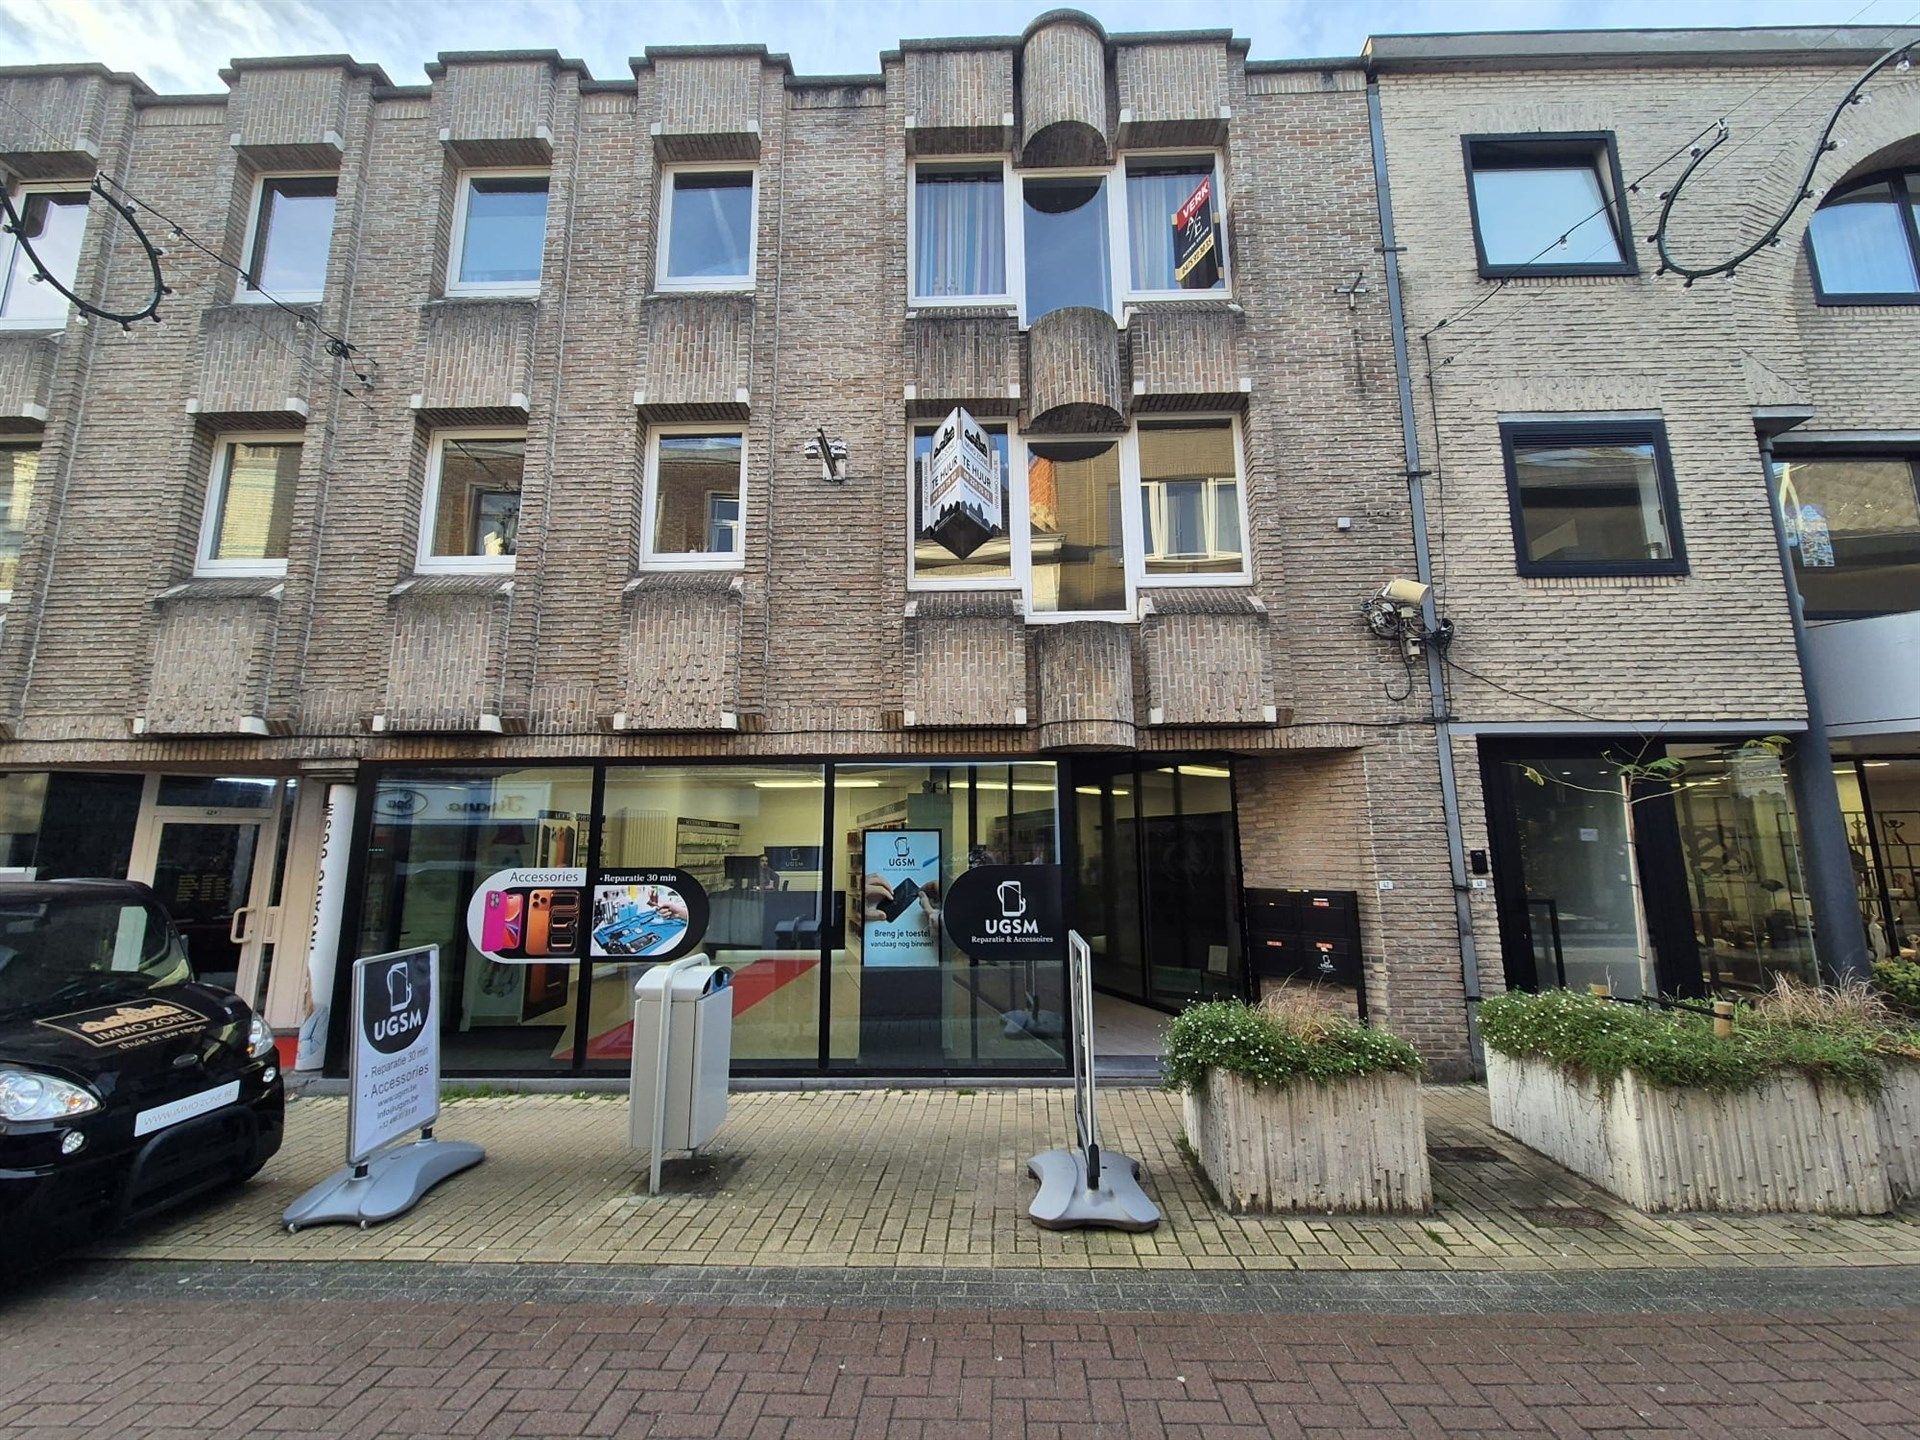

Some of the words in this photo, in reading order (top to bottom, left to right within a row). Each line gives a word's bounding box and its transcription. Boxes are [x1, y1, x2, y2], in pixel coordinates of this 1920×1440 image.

[962, 455, 971, 471] TE
[972, 465, 992, 490] HUUR
[932, 476, 939, 490] TE
[889, 858, 916, 867] UGSM
[509, 872, 578, 883] Accessories
[604, 873, 645, 884] Reparatie
[647, 874, 658, 882] 30
[659, 874, 677, 882] min
[985, 919, 1039, 934] UGSM
[874, 929, 896, 939] Breng
[897, 929, 905, 939] je
[905, 929, 931, 938] toestel
[971, 935, 1005, 945] Reparatie
[1013, 935, 1054, 943] Accessoires
[871, 941, 897, 949] vandaag
[94, 1023, 147, 1041] IMMO
[152, 1013, 197, 1028] ZONE
[374, 1008, 423, 1041] UGSM
[118, 1038, 149, 1050] thuis
[149, 1035, 162, 1043] in
[162, 1030, 179, 1039] uw
[371, 1056, 407, 1079] Reparatie
[408, 1050, 416, 1063] 30
[371, 1063, 430, 1098] Accessories
